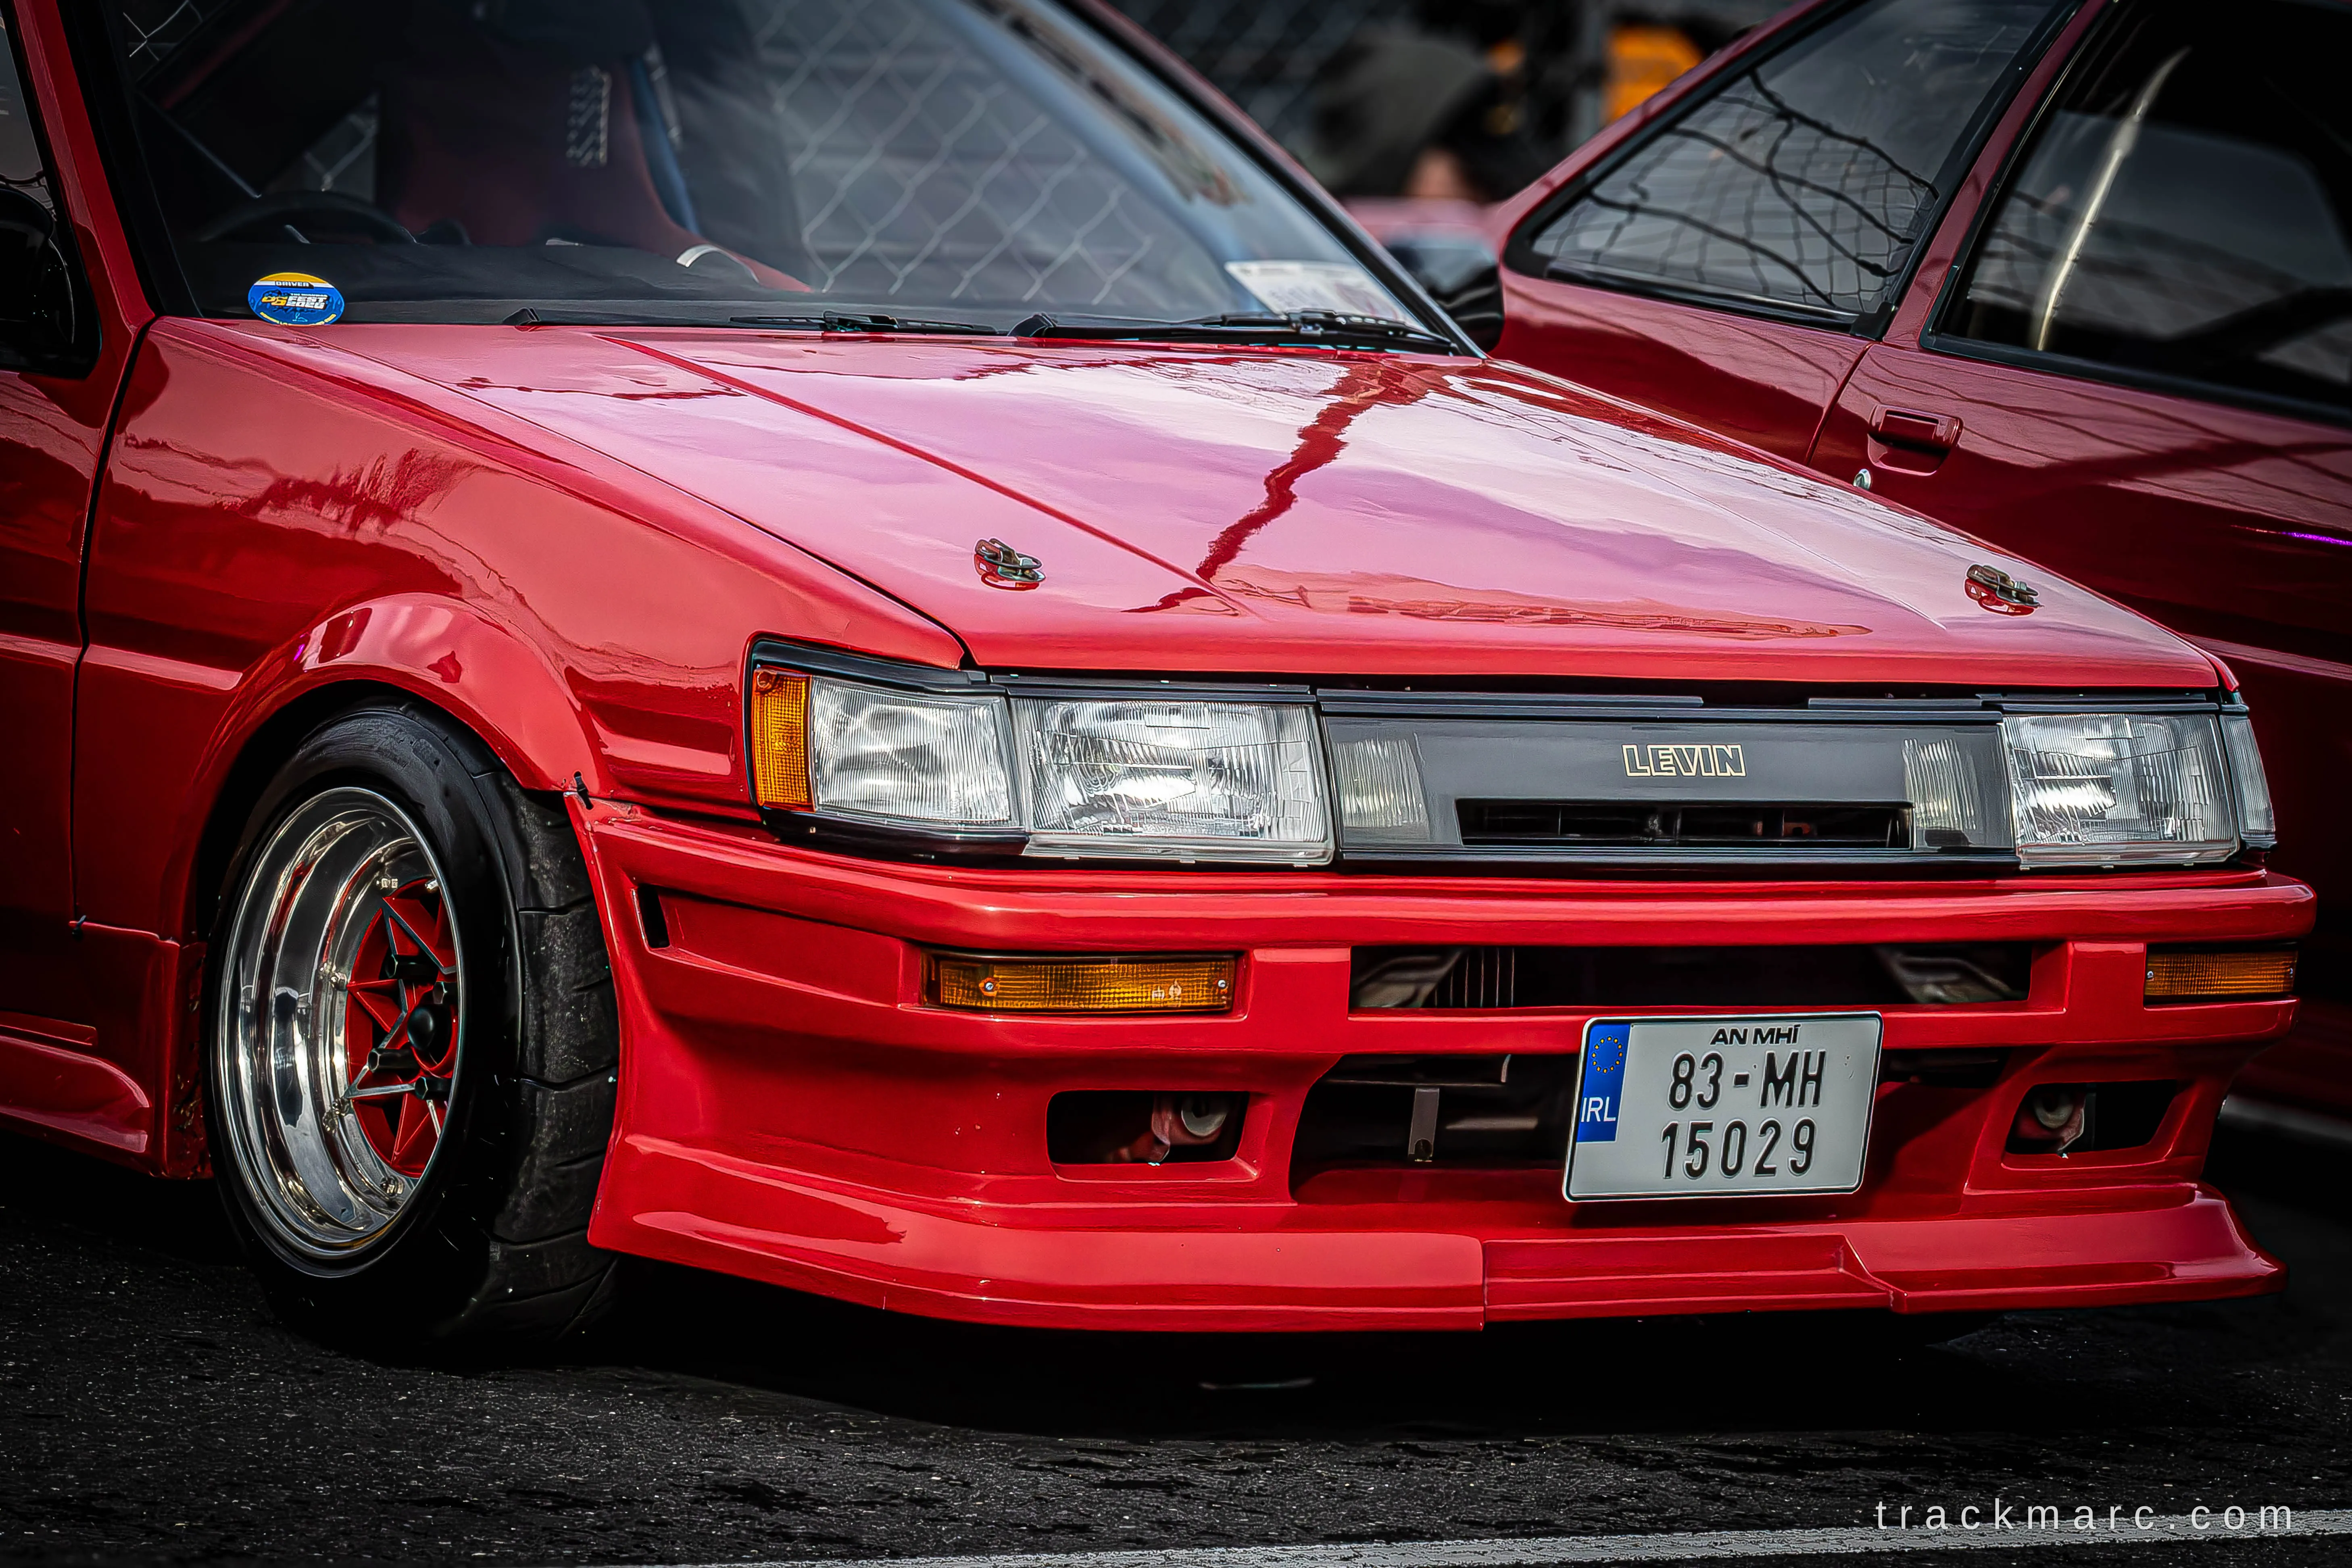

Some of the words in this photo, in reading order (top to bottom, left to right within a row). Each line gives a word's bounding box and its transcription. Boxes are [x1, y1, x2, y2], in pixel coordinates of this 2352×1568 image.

[1622, 744, 1747, 777] LEVIN
[1710, 1028, 1748, 1045] AN
[1668, 1051, 1826, 1109] 83-MH
[1581, 1097, 1616, 1122] IRL
[1661, 1118, 1816, 1180] 15029
